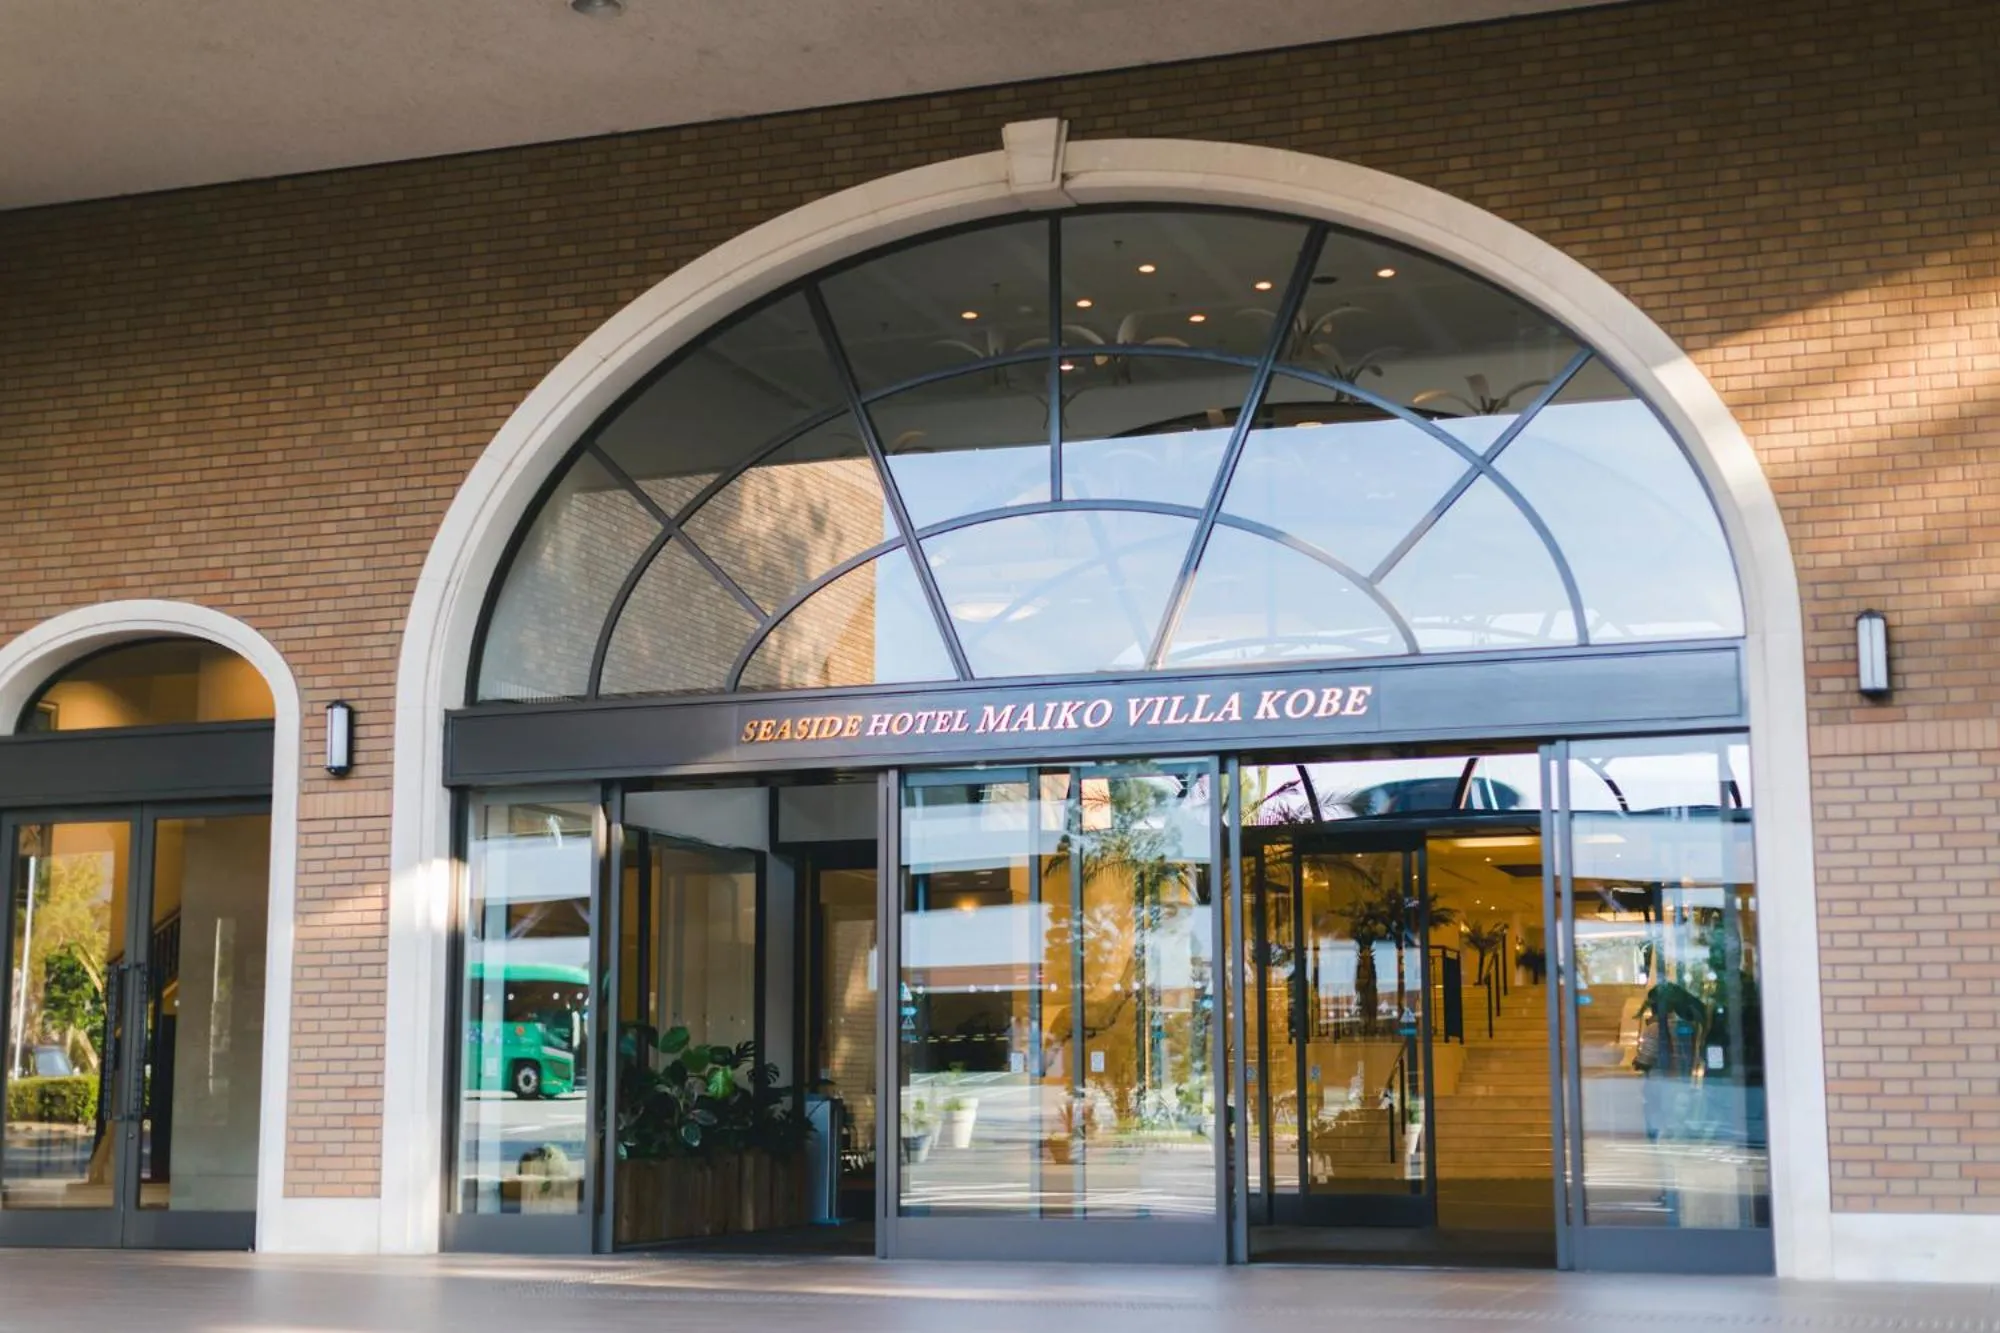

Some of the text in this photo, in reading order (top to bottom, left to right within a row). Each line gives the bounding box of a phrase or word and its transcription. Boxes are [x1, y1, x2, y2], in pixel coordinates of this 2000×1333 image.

[742, 686, 1373, 742] SEASIDE HOTEL MAIKO VILLA KOBE
